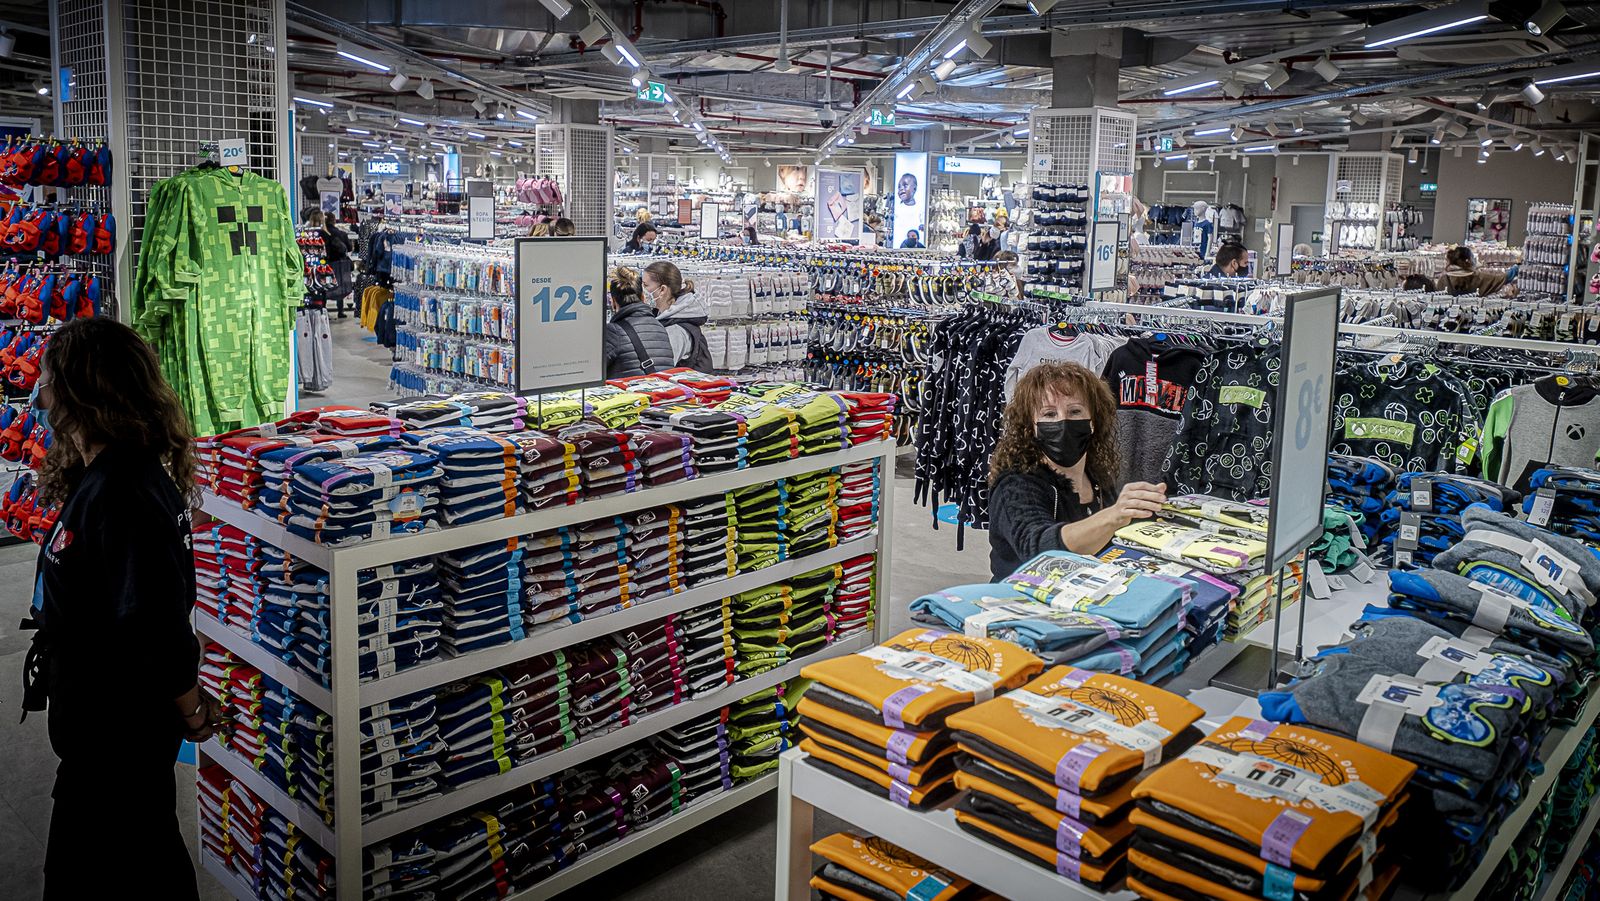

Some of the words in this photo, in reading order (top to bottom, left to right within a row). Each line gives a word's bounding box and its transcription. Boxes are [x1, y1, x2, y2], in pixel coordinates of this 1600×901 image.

[223, 146, 243, 158] 20€
[367, 162, 399, 174] LINGERIE
[1097, 244, 1114, 261] 16€
[532, 284, 593, 323] 12€
[1120, 375, 1183, 411] MAVEL
[1295, 373, 1324, 451] 8€
[1370, 423, 1405, 437] XBOX
[1103, 682, 1139, 699] PARIS
[1144, 705, 1160, 723] DUB
[1289, 732, 1332, 751] PARIS
[1340, 759, 1360, 781] DUB
